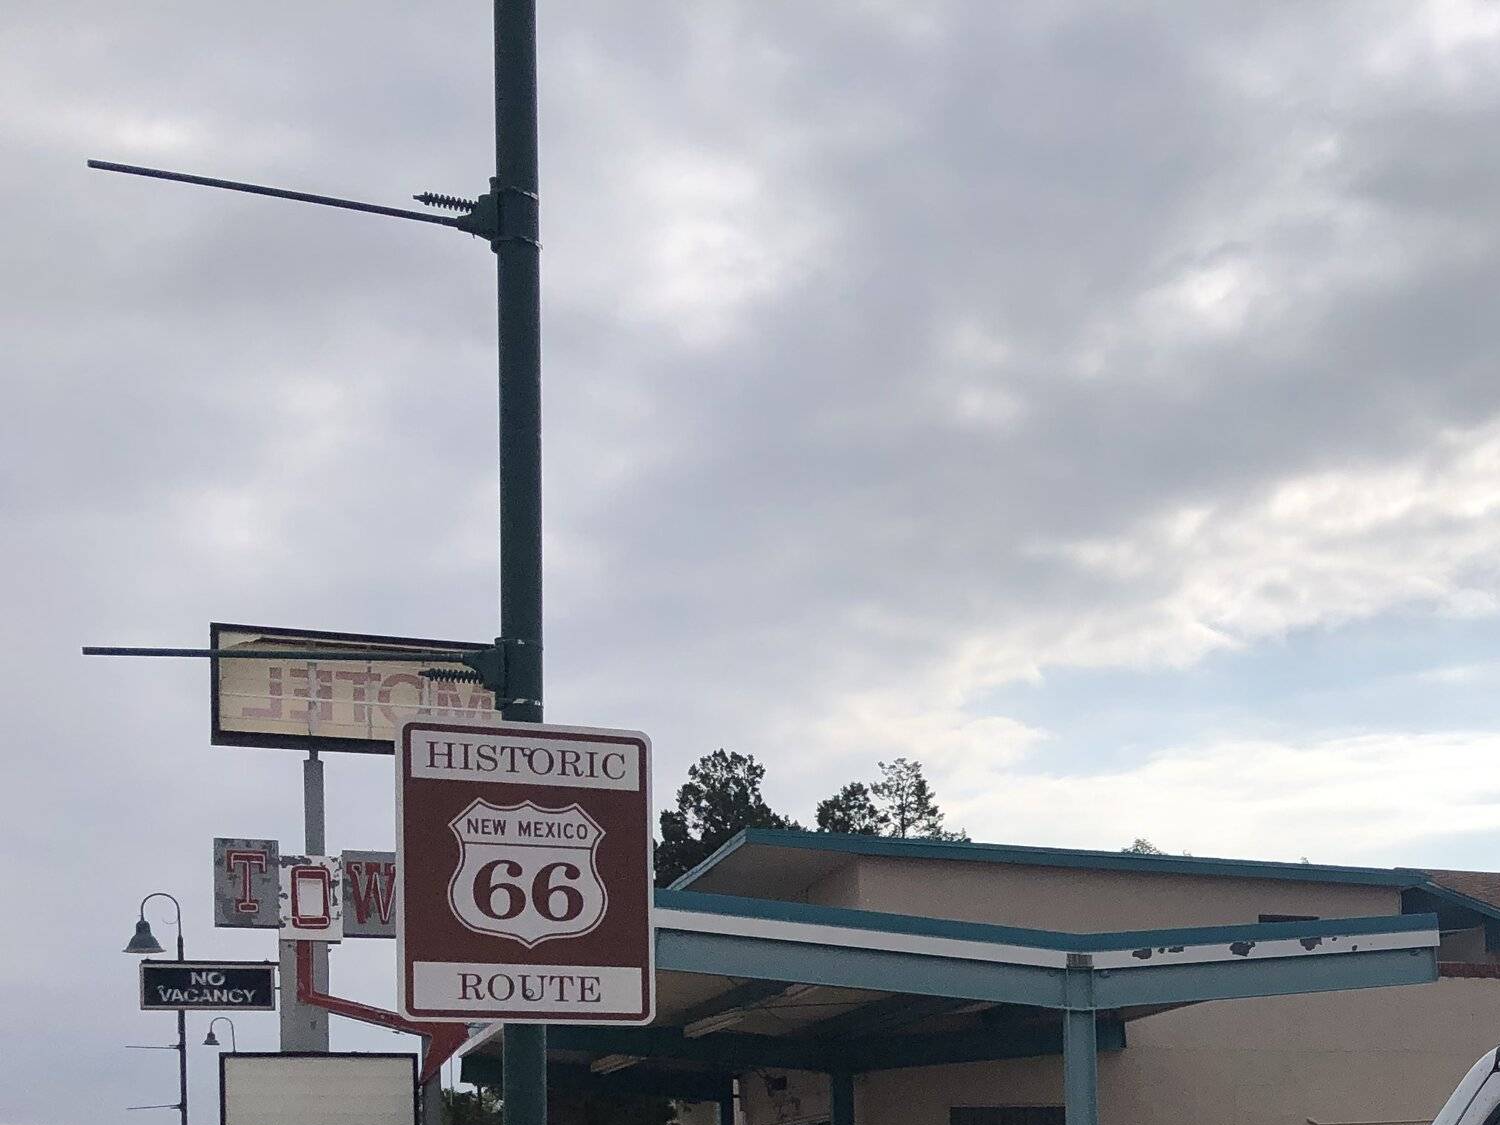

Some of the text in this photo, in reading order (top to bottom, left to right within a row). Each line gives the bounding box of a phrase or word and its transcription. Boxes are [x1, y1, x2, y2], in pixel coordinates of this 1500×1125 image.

[425, 741, 627, 780] HISTORIC
[466, 818, 588, 840] NEW MEXICO
[473, 859, 584, 922] 66
[191, 971, 226, 986] NO
[457, 972, 601, 1004] ROUTE
[158, 987, 257, 1002] VACANCY
